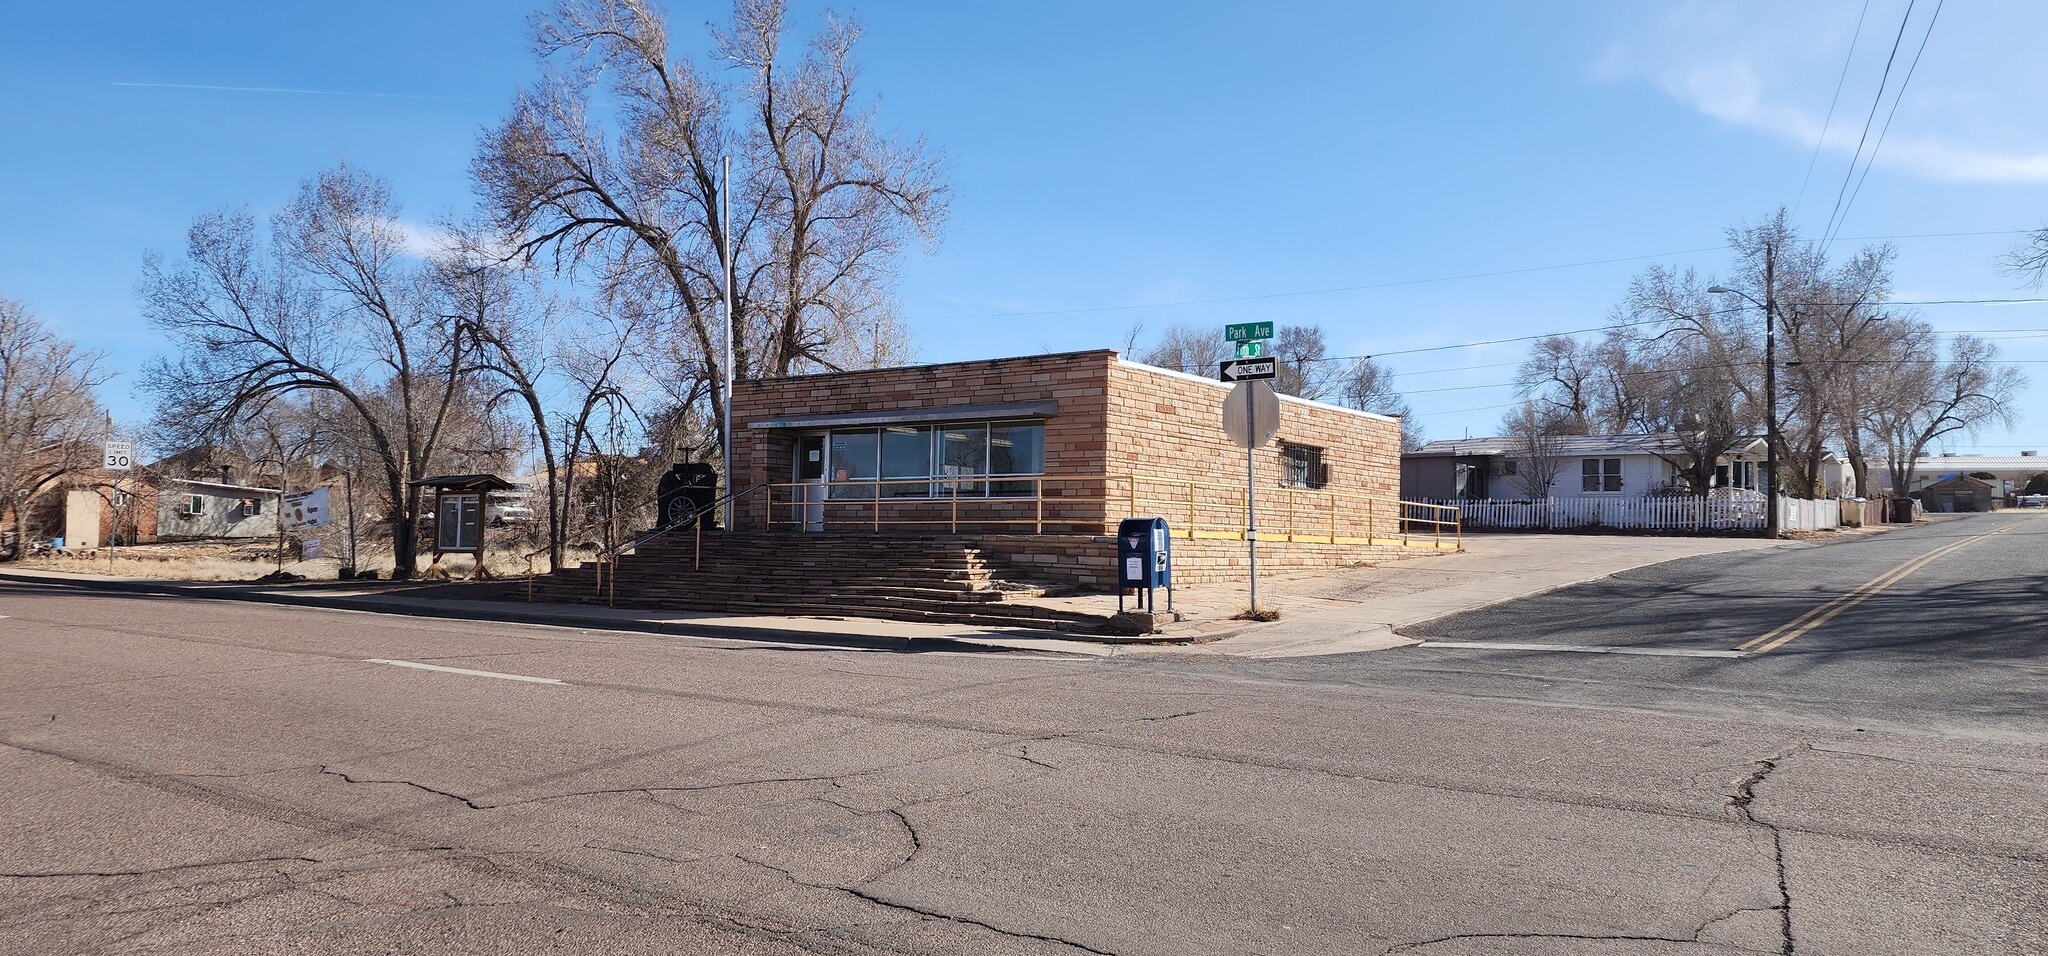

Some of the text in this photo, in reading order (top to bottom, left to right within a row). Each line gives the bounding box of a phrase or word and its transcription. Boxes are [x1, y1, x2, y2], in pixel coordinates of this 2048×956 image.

[1229, 325, 1270, 339] Park Ave
[1238, 364, 1271, 375] ONE WAY
[107, 456, 128, 466] 30
